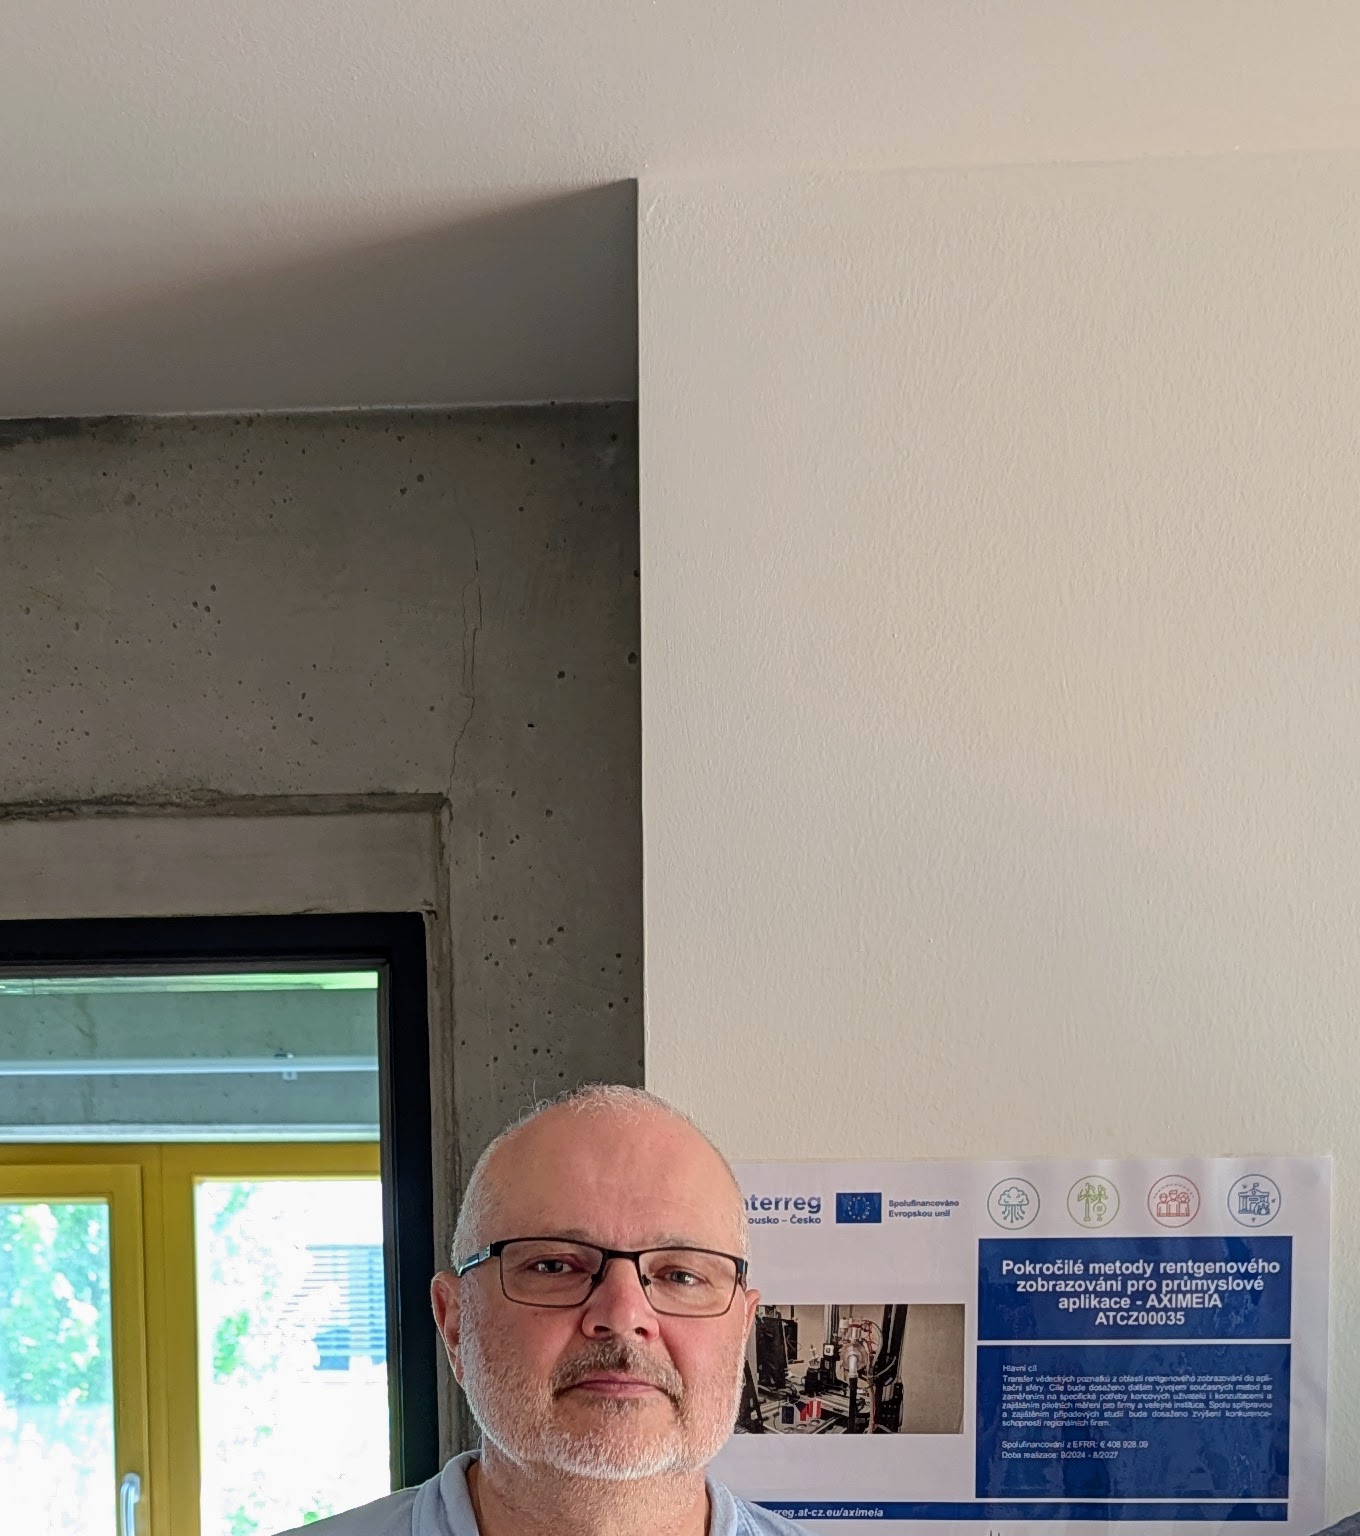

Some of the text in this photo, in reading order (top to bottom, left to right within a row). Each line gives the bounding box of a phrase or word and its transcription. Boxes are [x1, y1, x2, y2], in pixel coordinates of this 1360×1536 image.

[743, 1194, 822, 1214] terreg
[748, 1215, 780, 1225] ousko
[790, 1214, 822, 1225] Česko
[888, 1210, 933, 1219] Evropskou
[1001, 1259, 1280, 1277] Pokročilé metody rentgenového
[1016, 1276, 1264, 1295] zobrazování pro průmyslové
[1058, 1294, 1131, 1312] aplikace
[1146, 1293, 1222, 1309] AXIMEIA
[1095, 1311, 1185, 1326] ATCZ00035
